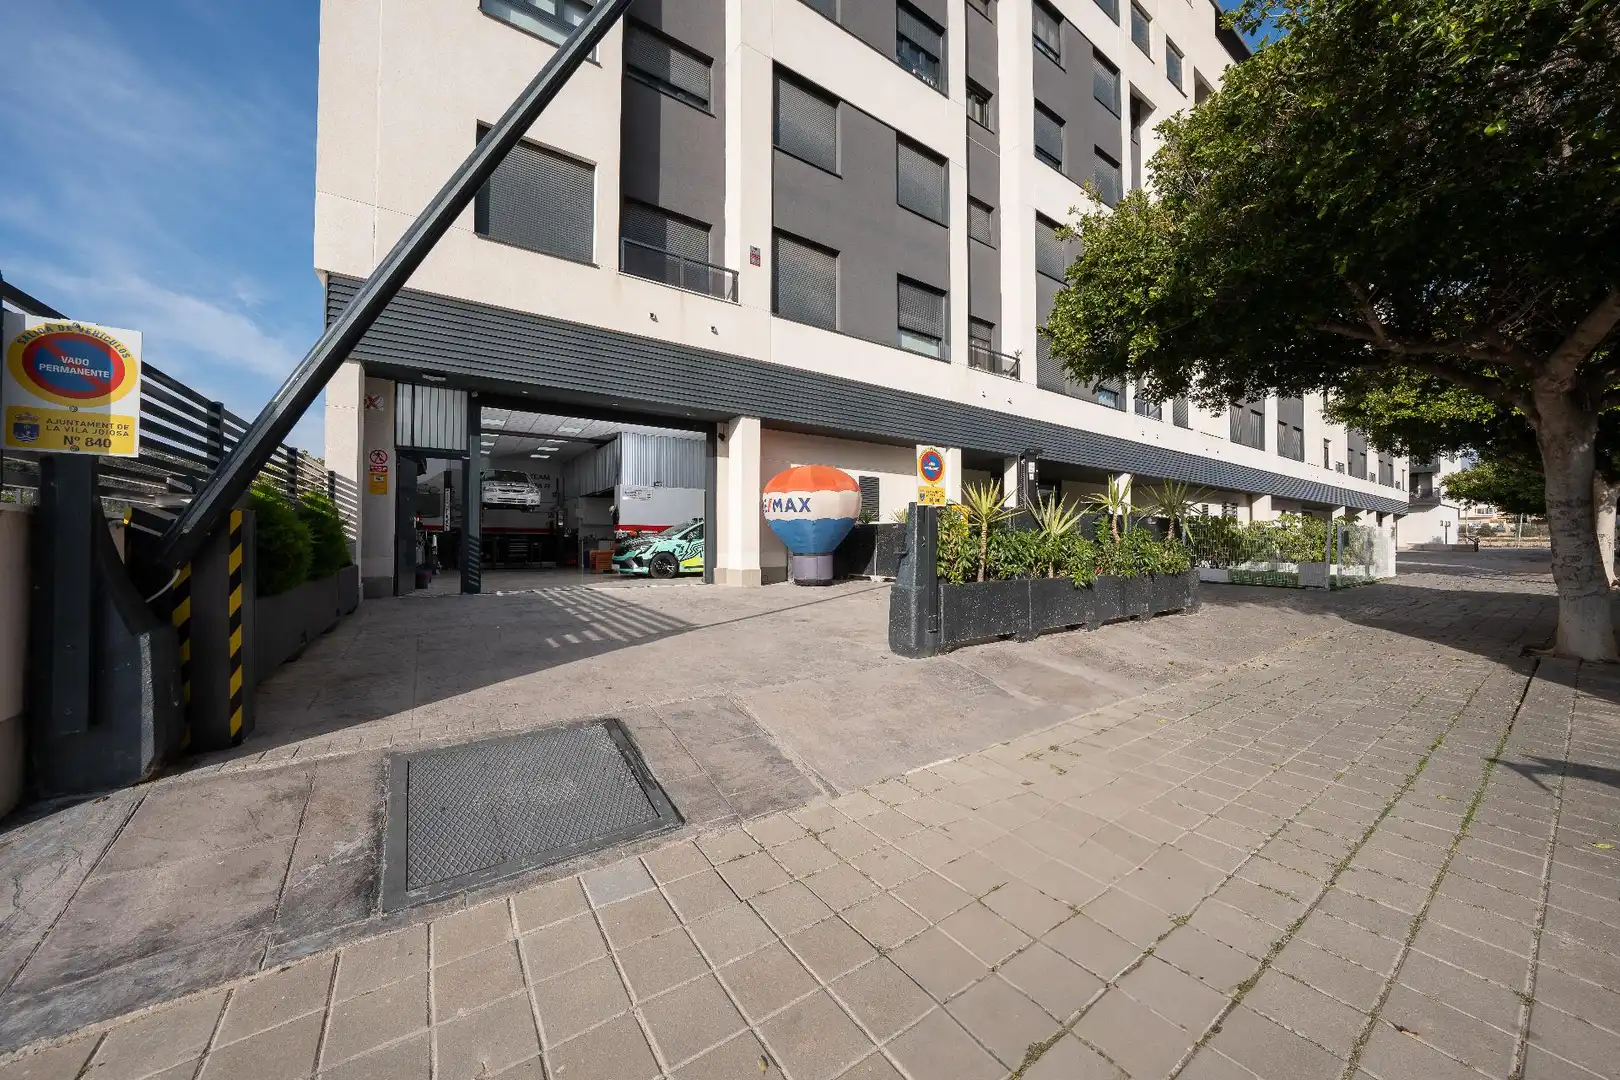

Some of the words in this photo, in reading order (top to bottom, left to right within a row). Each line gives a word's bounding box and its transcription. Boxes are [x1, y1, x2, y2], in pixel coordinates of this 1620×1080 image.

[16, 324, 53, 345] SALIDA
[57, 324, 72, 332] DE
[61, 356, 89, 366] VADO
[39, 363, 110, 378] PERMANENTE
[46, 418, 113, 429] AJUNTAMENT
[64, 426, 88, 434] VILA
[92, 429, 129, 437] JOIOSA
[85, 437, 112, 448] 840
